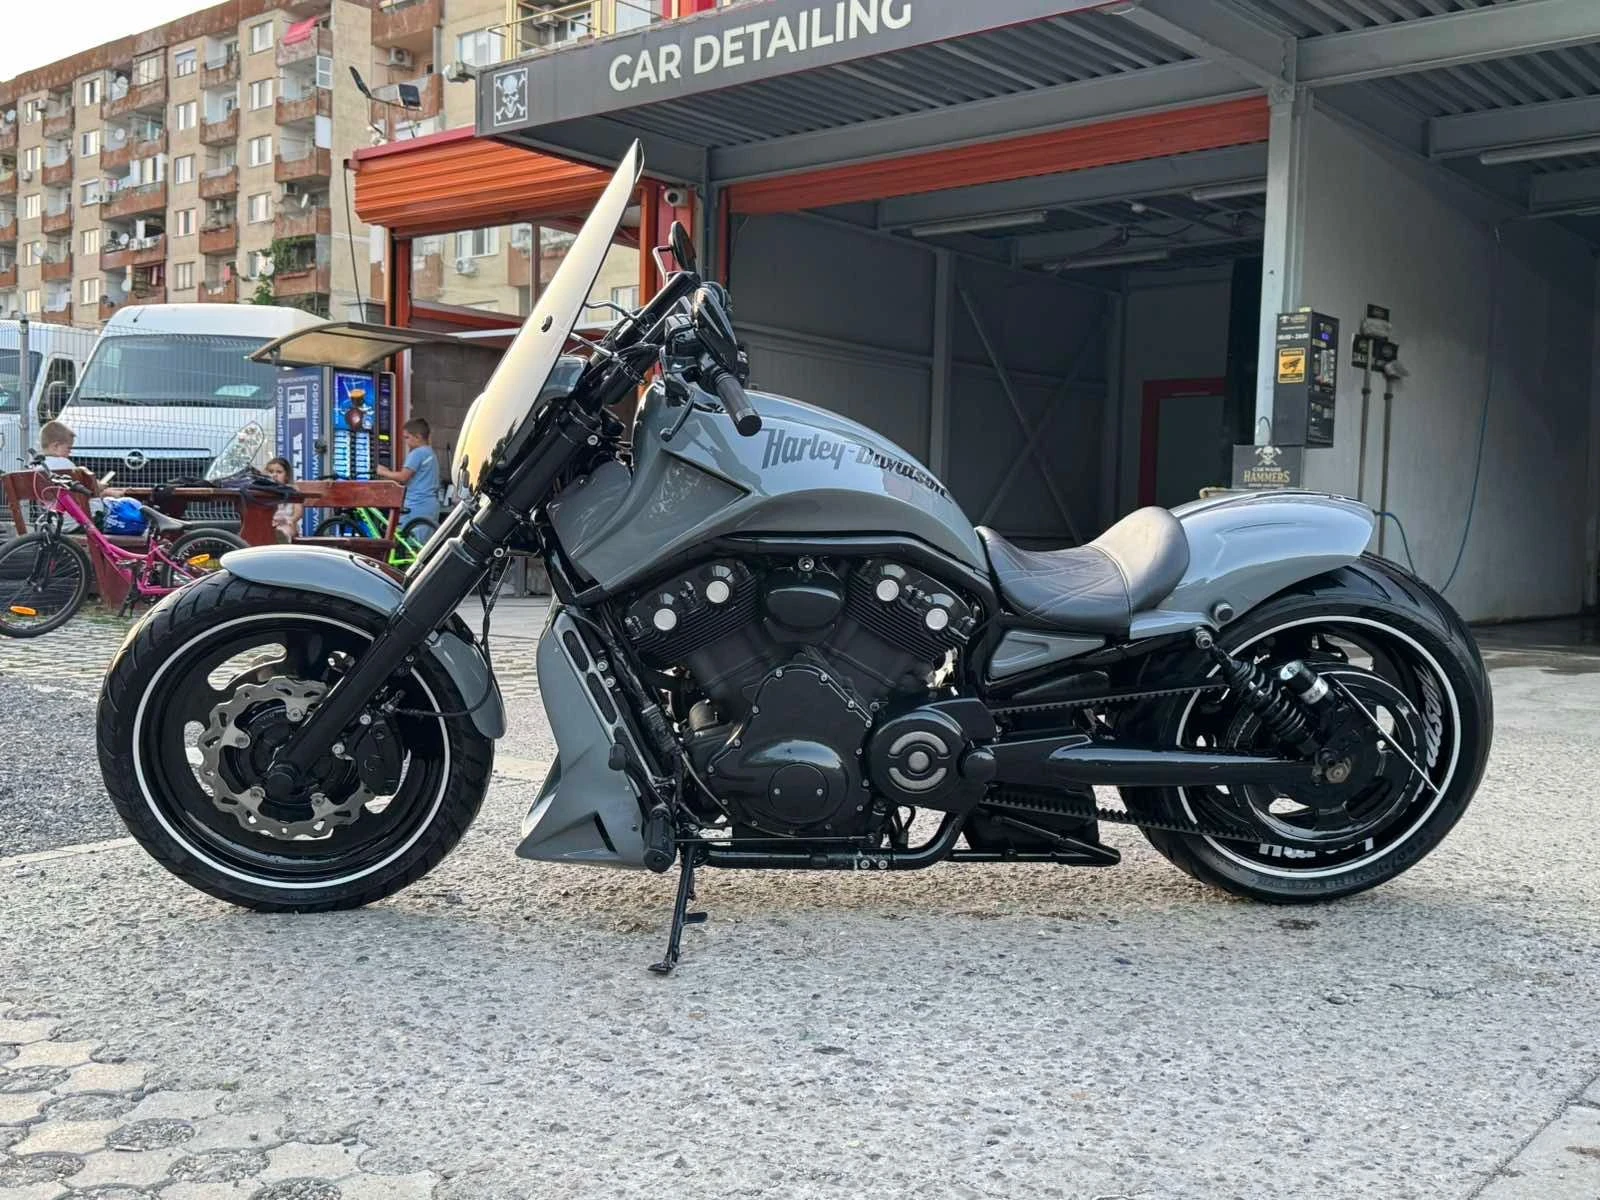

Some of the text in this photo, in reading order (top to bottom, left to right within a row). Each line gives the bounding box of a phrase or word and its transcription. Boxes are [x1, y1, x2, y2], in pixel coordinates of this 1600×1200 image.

[609, 0, 912, 91] CAR DETAILING
[1243, 470, 1290, 483] HAMMERS
